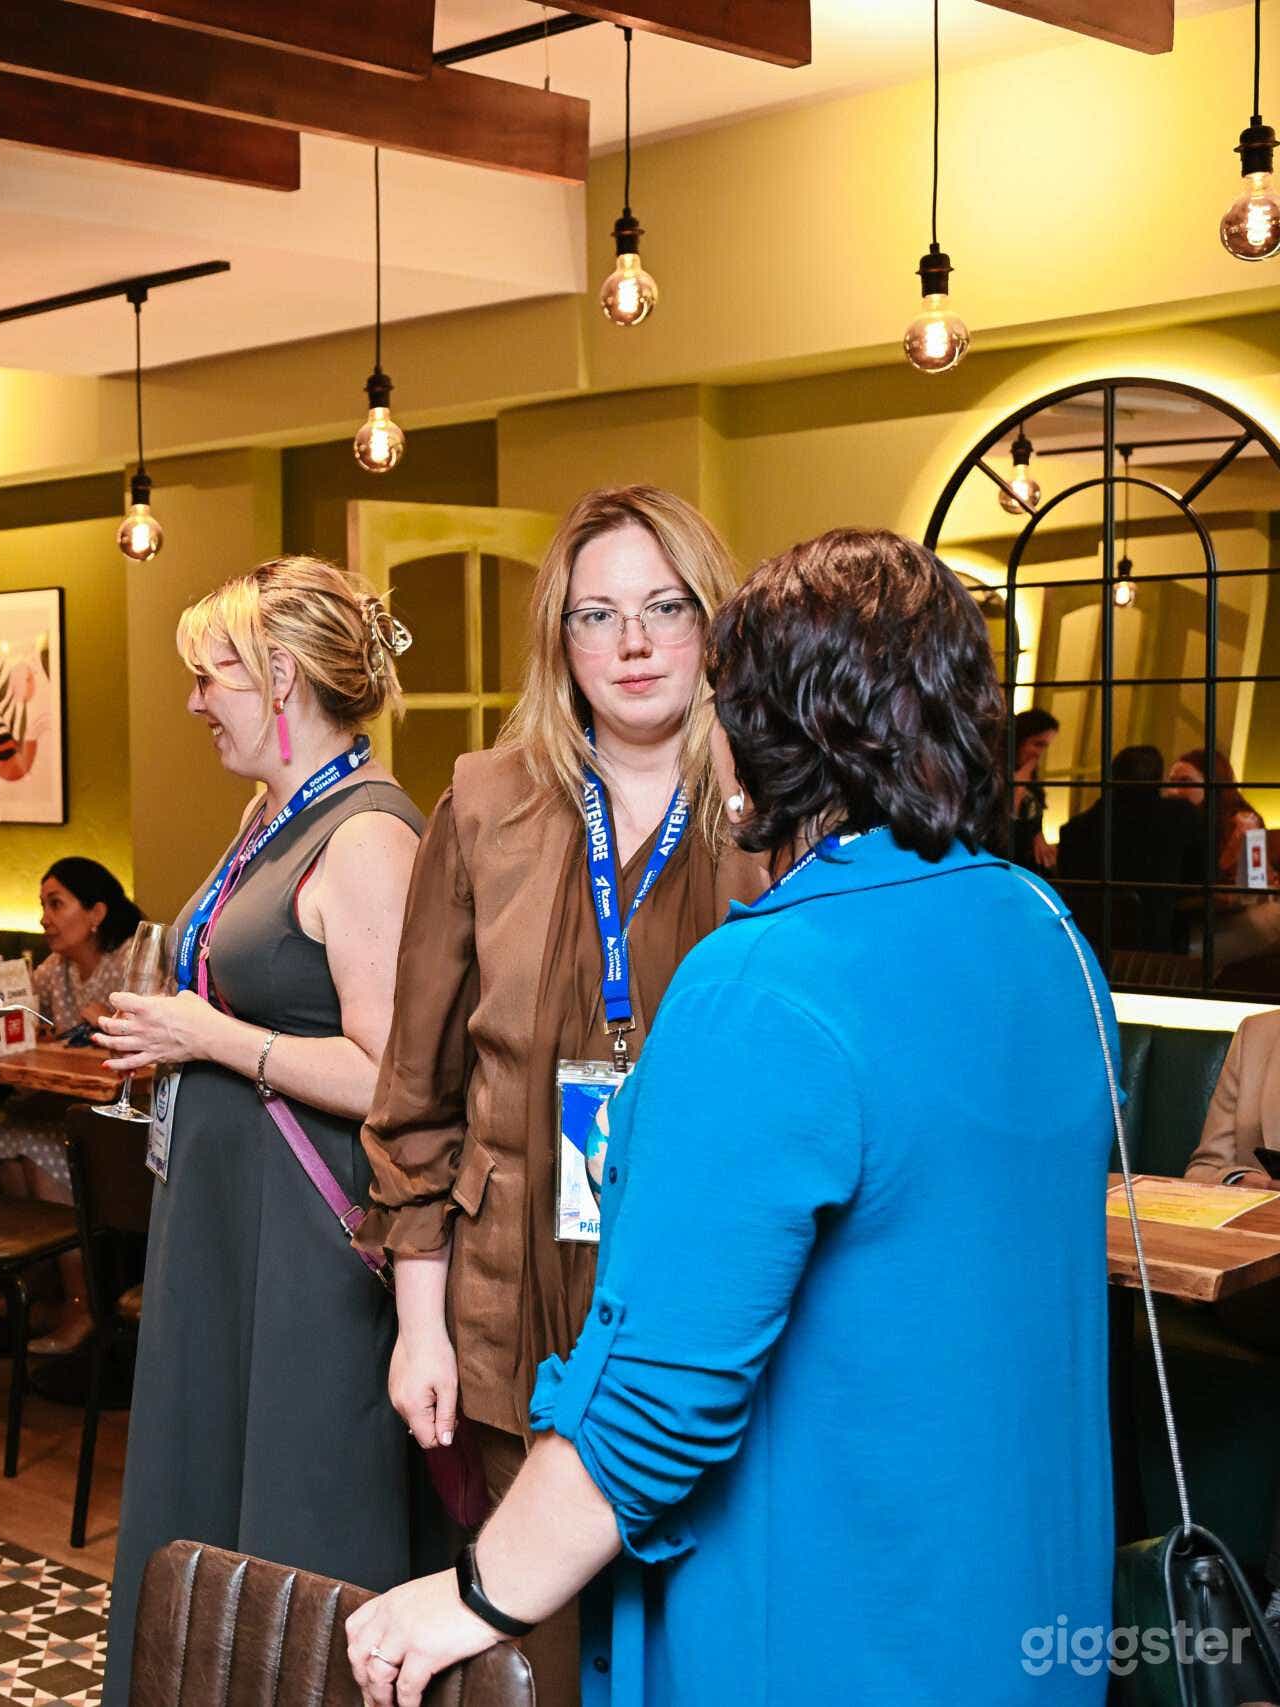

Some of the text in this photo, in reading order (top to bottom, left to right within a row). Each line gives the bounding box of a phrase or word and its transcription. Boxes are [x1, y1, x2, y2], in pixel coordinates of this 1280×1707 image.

[309, 765, 337, 788] DOMAIN
[313, 771, 341, 793] SUMMIT
[584, 783, 609, 863] ATTENDEE
[659, 782, 689, 857] ATTEN
[607, 951, 615, 982] SUMMIT
[614, 948, 622, 981] DOMAIN
